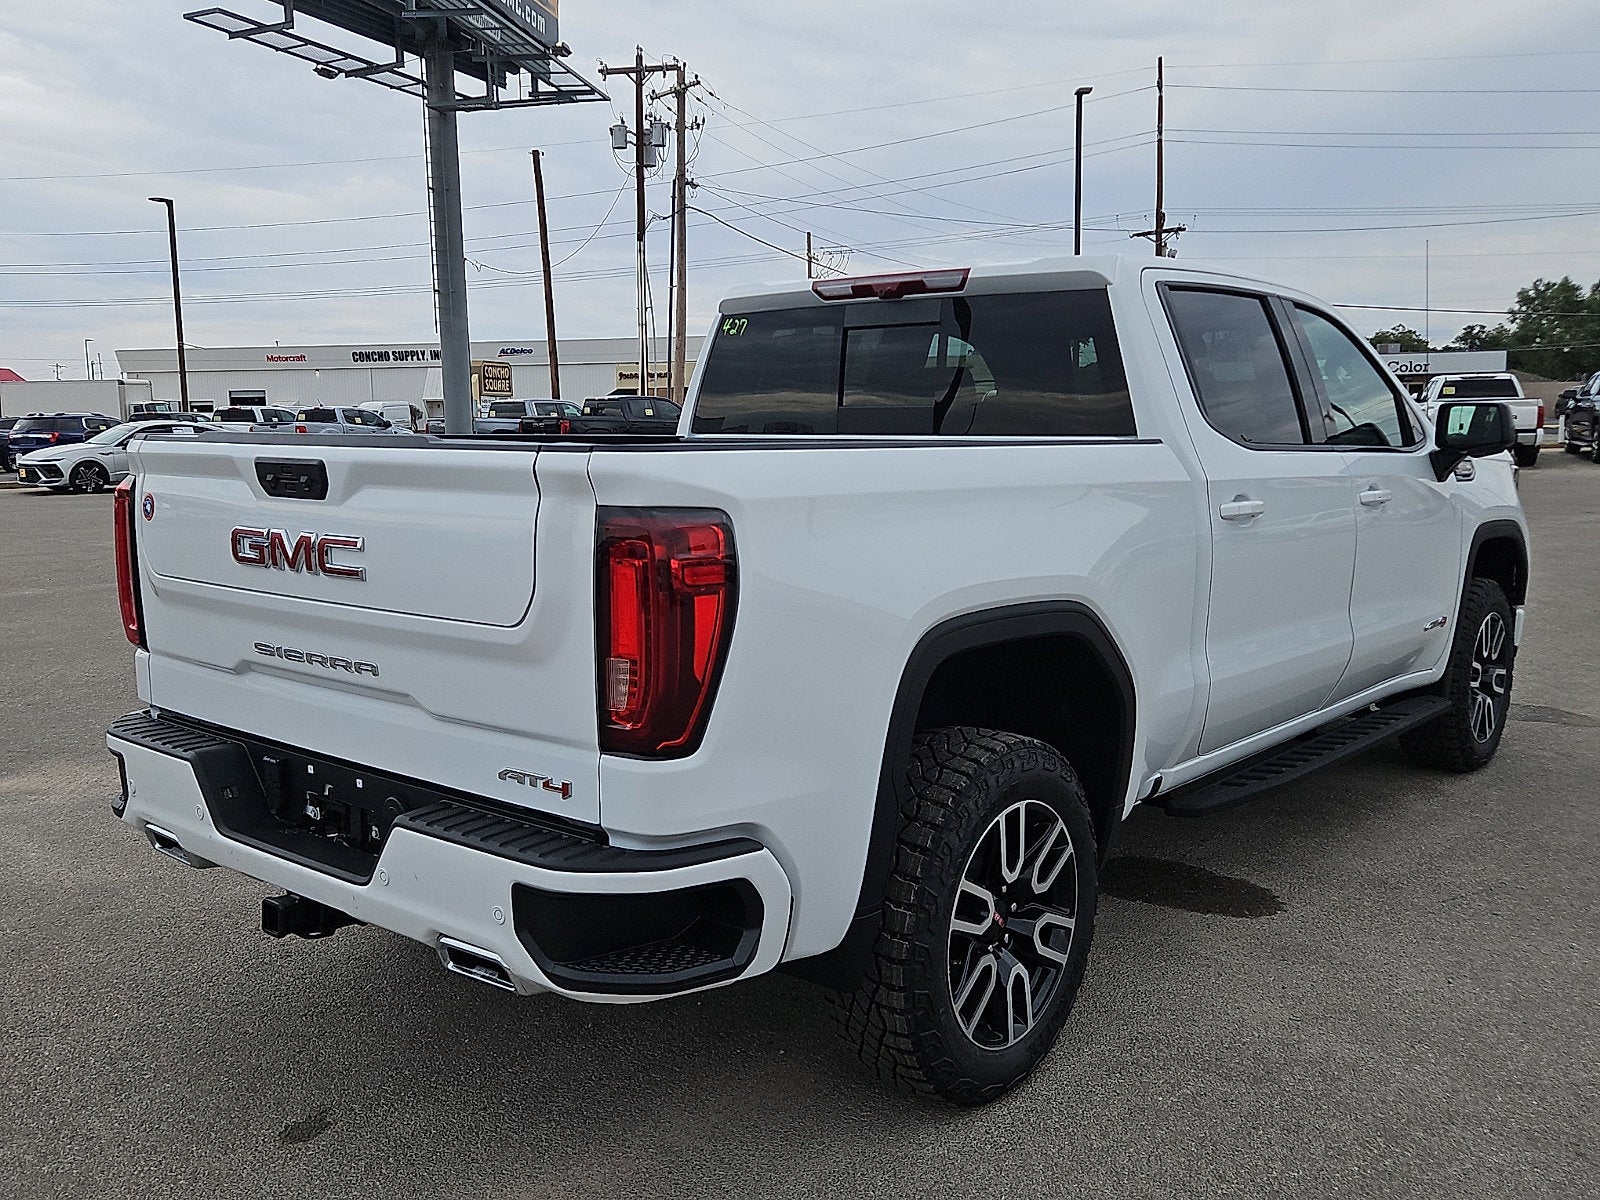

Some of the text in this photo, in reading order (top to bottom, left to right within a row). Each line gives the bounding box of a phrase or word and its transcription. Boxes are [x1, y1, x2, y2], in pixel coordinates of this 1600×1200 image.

[500, 0, 546, 36] MC.com
[723, 318, 748, 336] 427
[266, 353, 307, 363] Motorcraft
[351, 349, 442, 363] CONCHO SUPPLY, IN
[499, 347, 534, 355] ACDelco
[484, 366, 510, 380] CONCHO
[1387, 360, 1431, 373] Color
[485, 379, 510, 392] SQUARE
[231, 525, 367, 582] GMC
[253, 641, 380, 678] SIERRA
[497, 767, 573, 801] AT4
